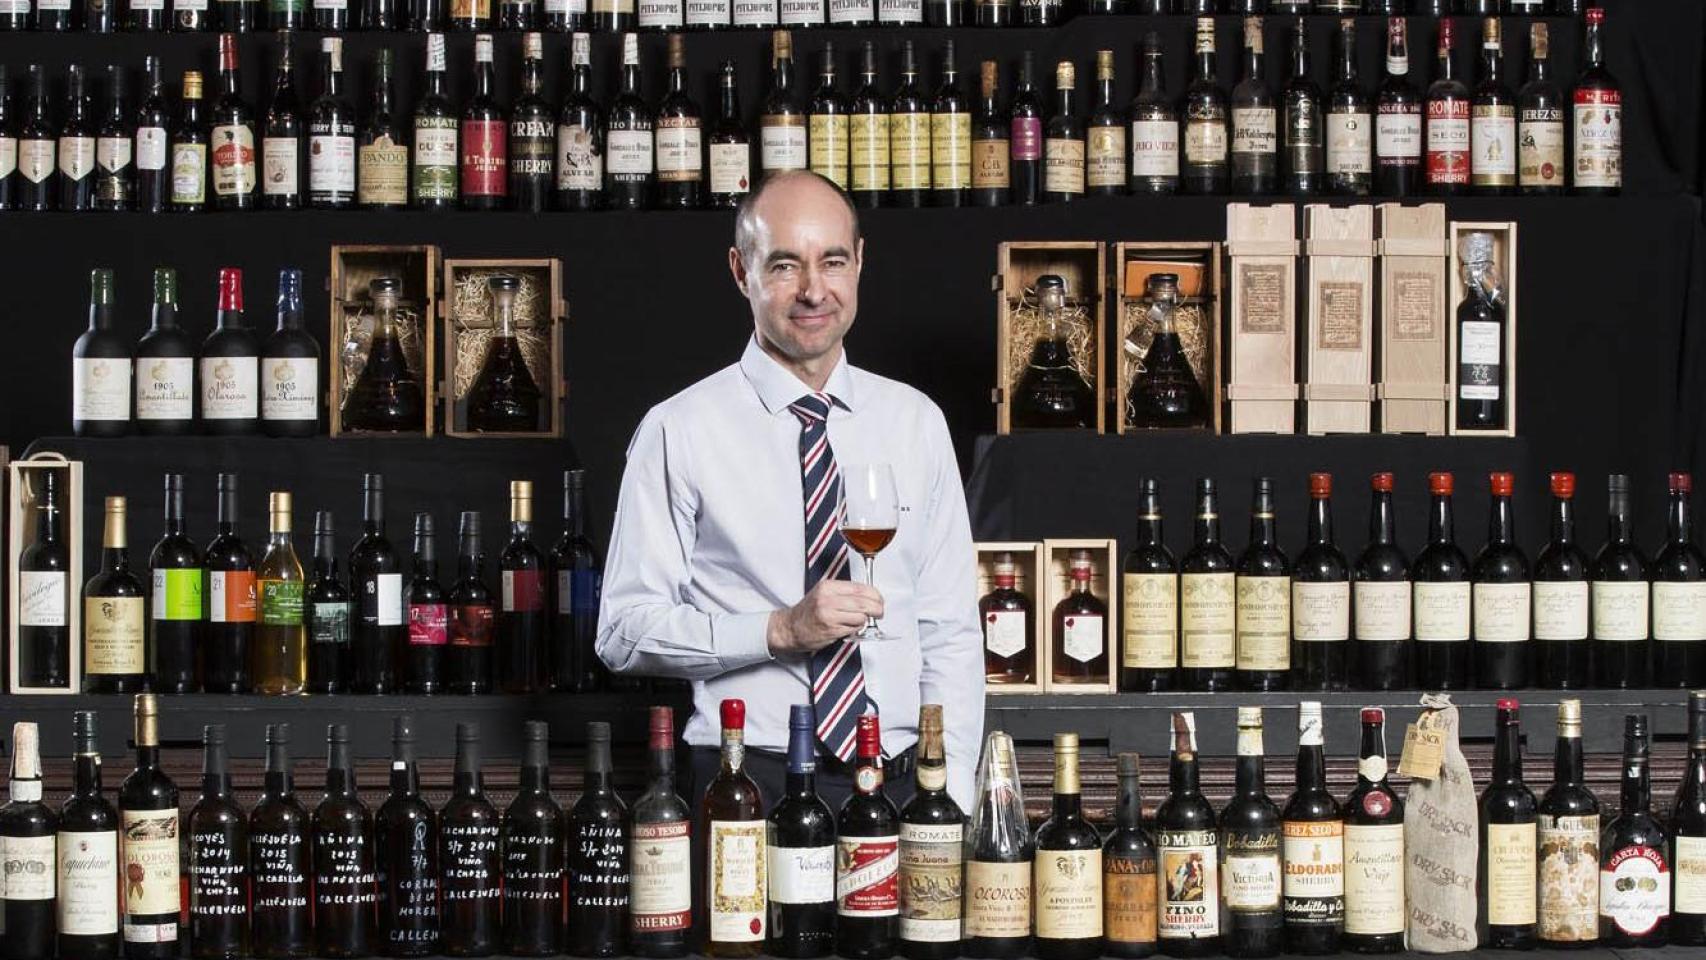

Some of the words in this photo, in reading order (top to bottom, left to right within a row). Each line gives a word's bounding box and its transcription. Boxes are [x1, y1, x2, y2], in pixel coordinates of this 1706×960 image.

[415, 117, 457, 128] ROMATE
[511, 121, 554, 138] CREAM
[511, 159, 552, 174] SHERRY
[418, 187, 454, 198] SHERRY
[155, 575, 164, 588] 22
[320, 832, 365, 845] AÑINA
[909, 829, 961, 842] ROMATE
[1172, 832, 1216, 847] MATEO
[1226, 833, 1279, 849] Bobadilla
[260, 848, 288, 858] 2015
[1610, 849, 1640, 867] CARTA
[1643, 848, 1663, 868] ROJA
[1413, 854, 1441, 876] DRY
[1439, 867, 1473, 890] SACK
[1166, 905, 1206, 915] FINO
[635, 914, 684, 930] SHERRY
[1165, 914, 1205, 924] SHERRY
[1412, 907, 1439, 929] DRY
